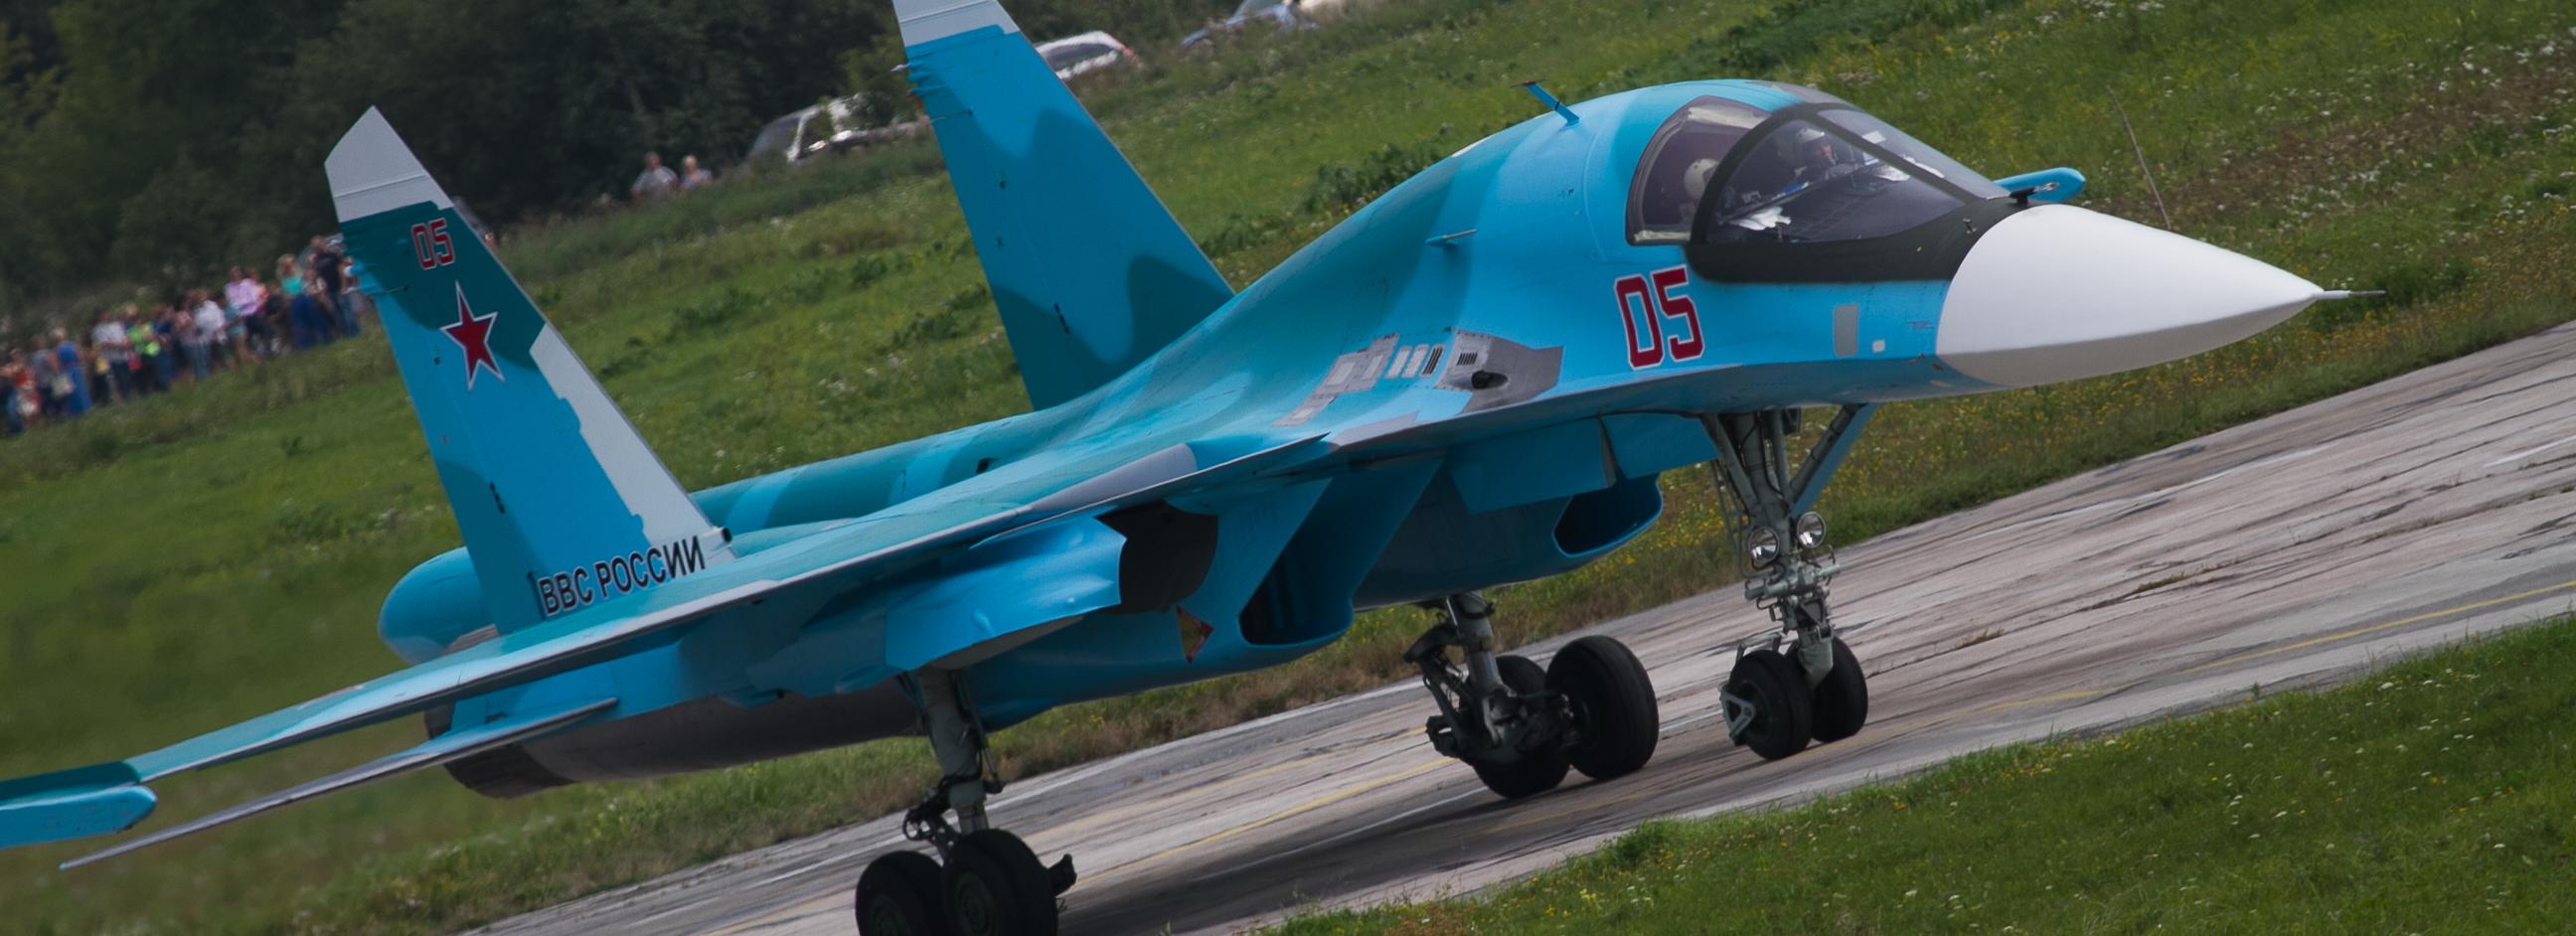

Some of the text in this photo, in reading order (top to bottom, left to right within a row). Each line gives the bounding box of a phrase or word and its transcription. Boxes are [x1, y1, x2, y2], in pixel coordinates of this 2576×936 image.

[411, 219, 454, 269] 05
[1615, 265, 1704, 370] 05
[539, 536, 706, 616] ВВС РОССИИ
